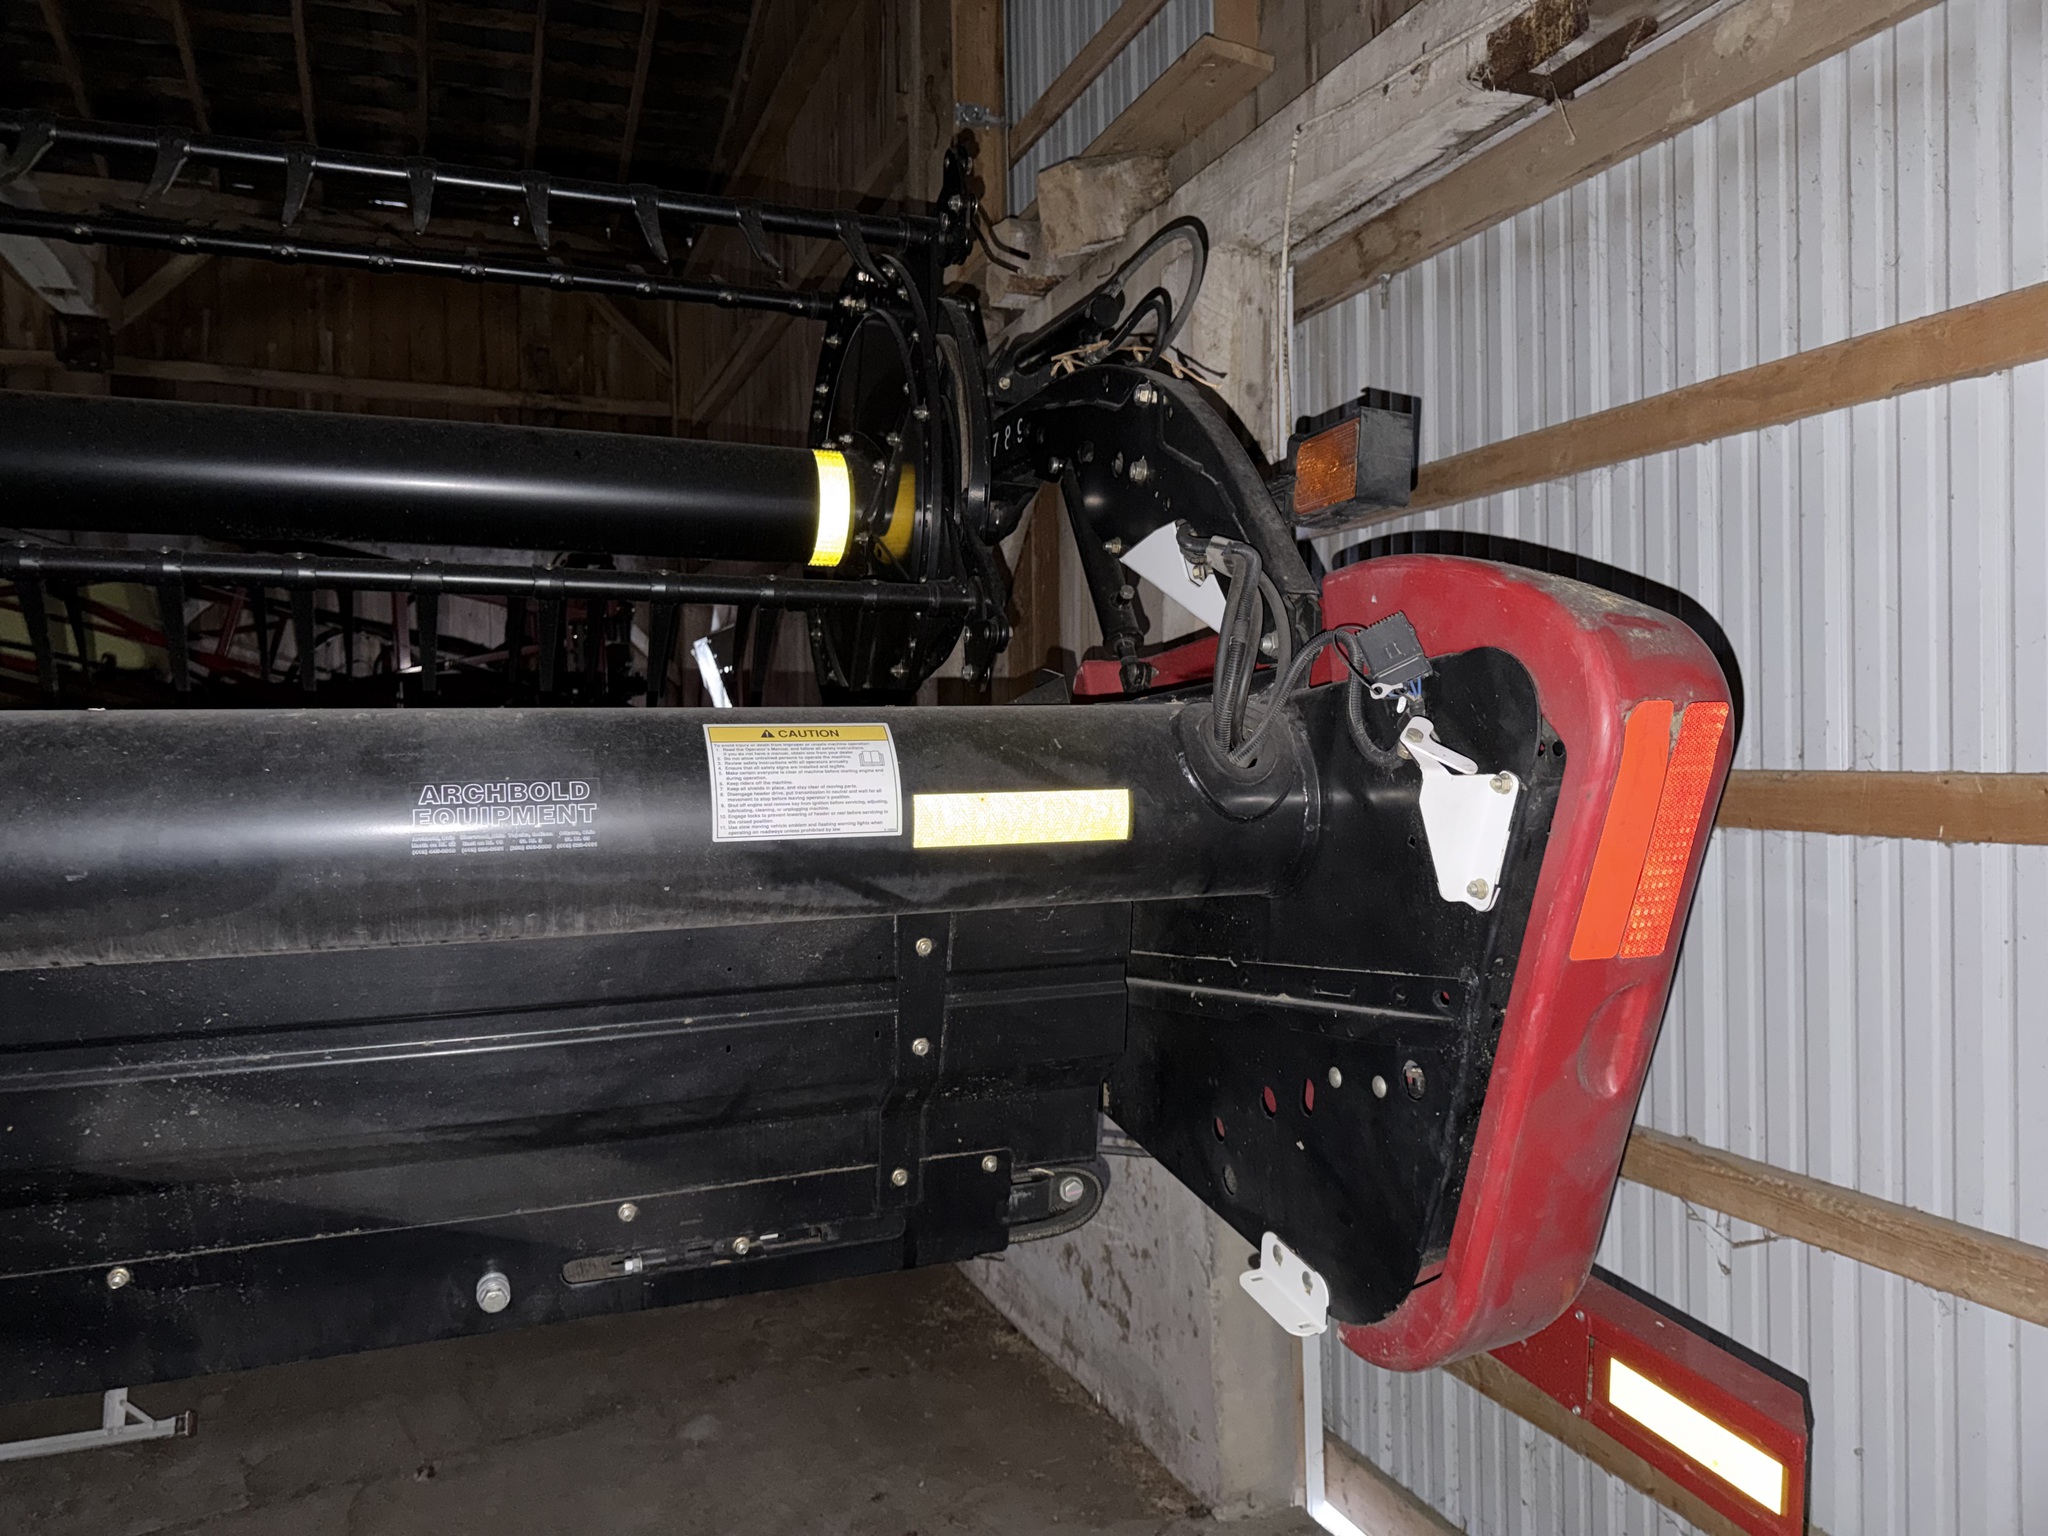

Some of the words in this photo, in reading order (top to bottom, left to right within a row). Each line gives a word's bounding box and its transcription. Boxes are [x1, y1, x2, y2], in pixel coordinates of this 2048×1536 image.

[778, 730, 840, 738] CAUTION
[418, 781, 590, 806] ARCHBOLD
[412, 803, 597, 827] EQUIPMENT
